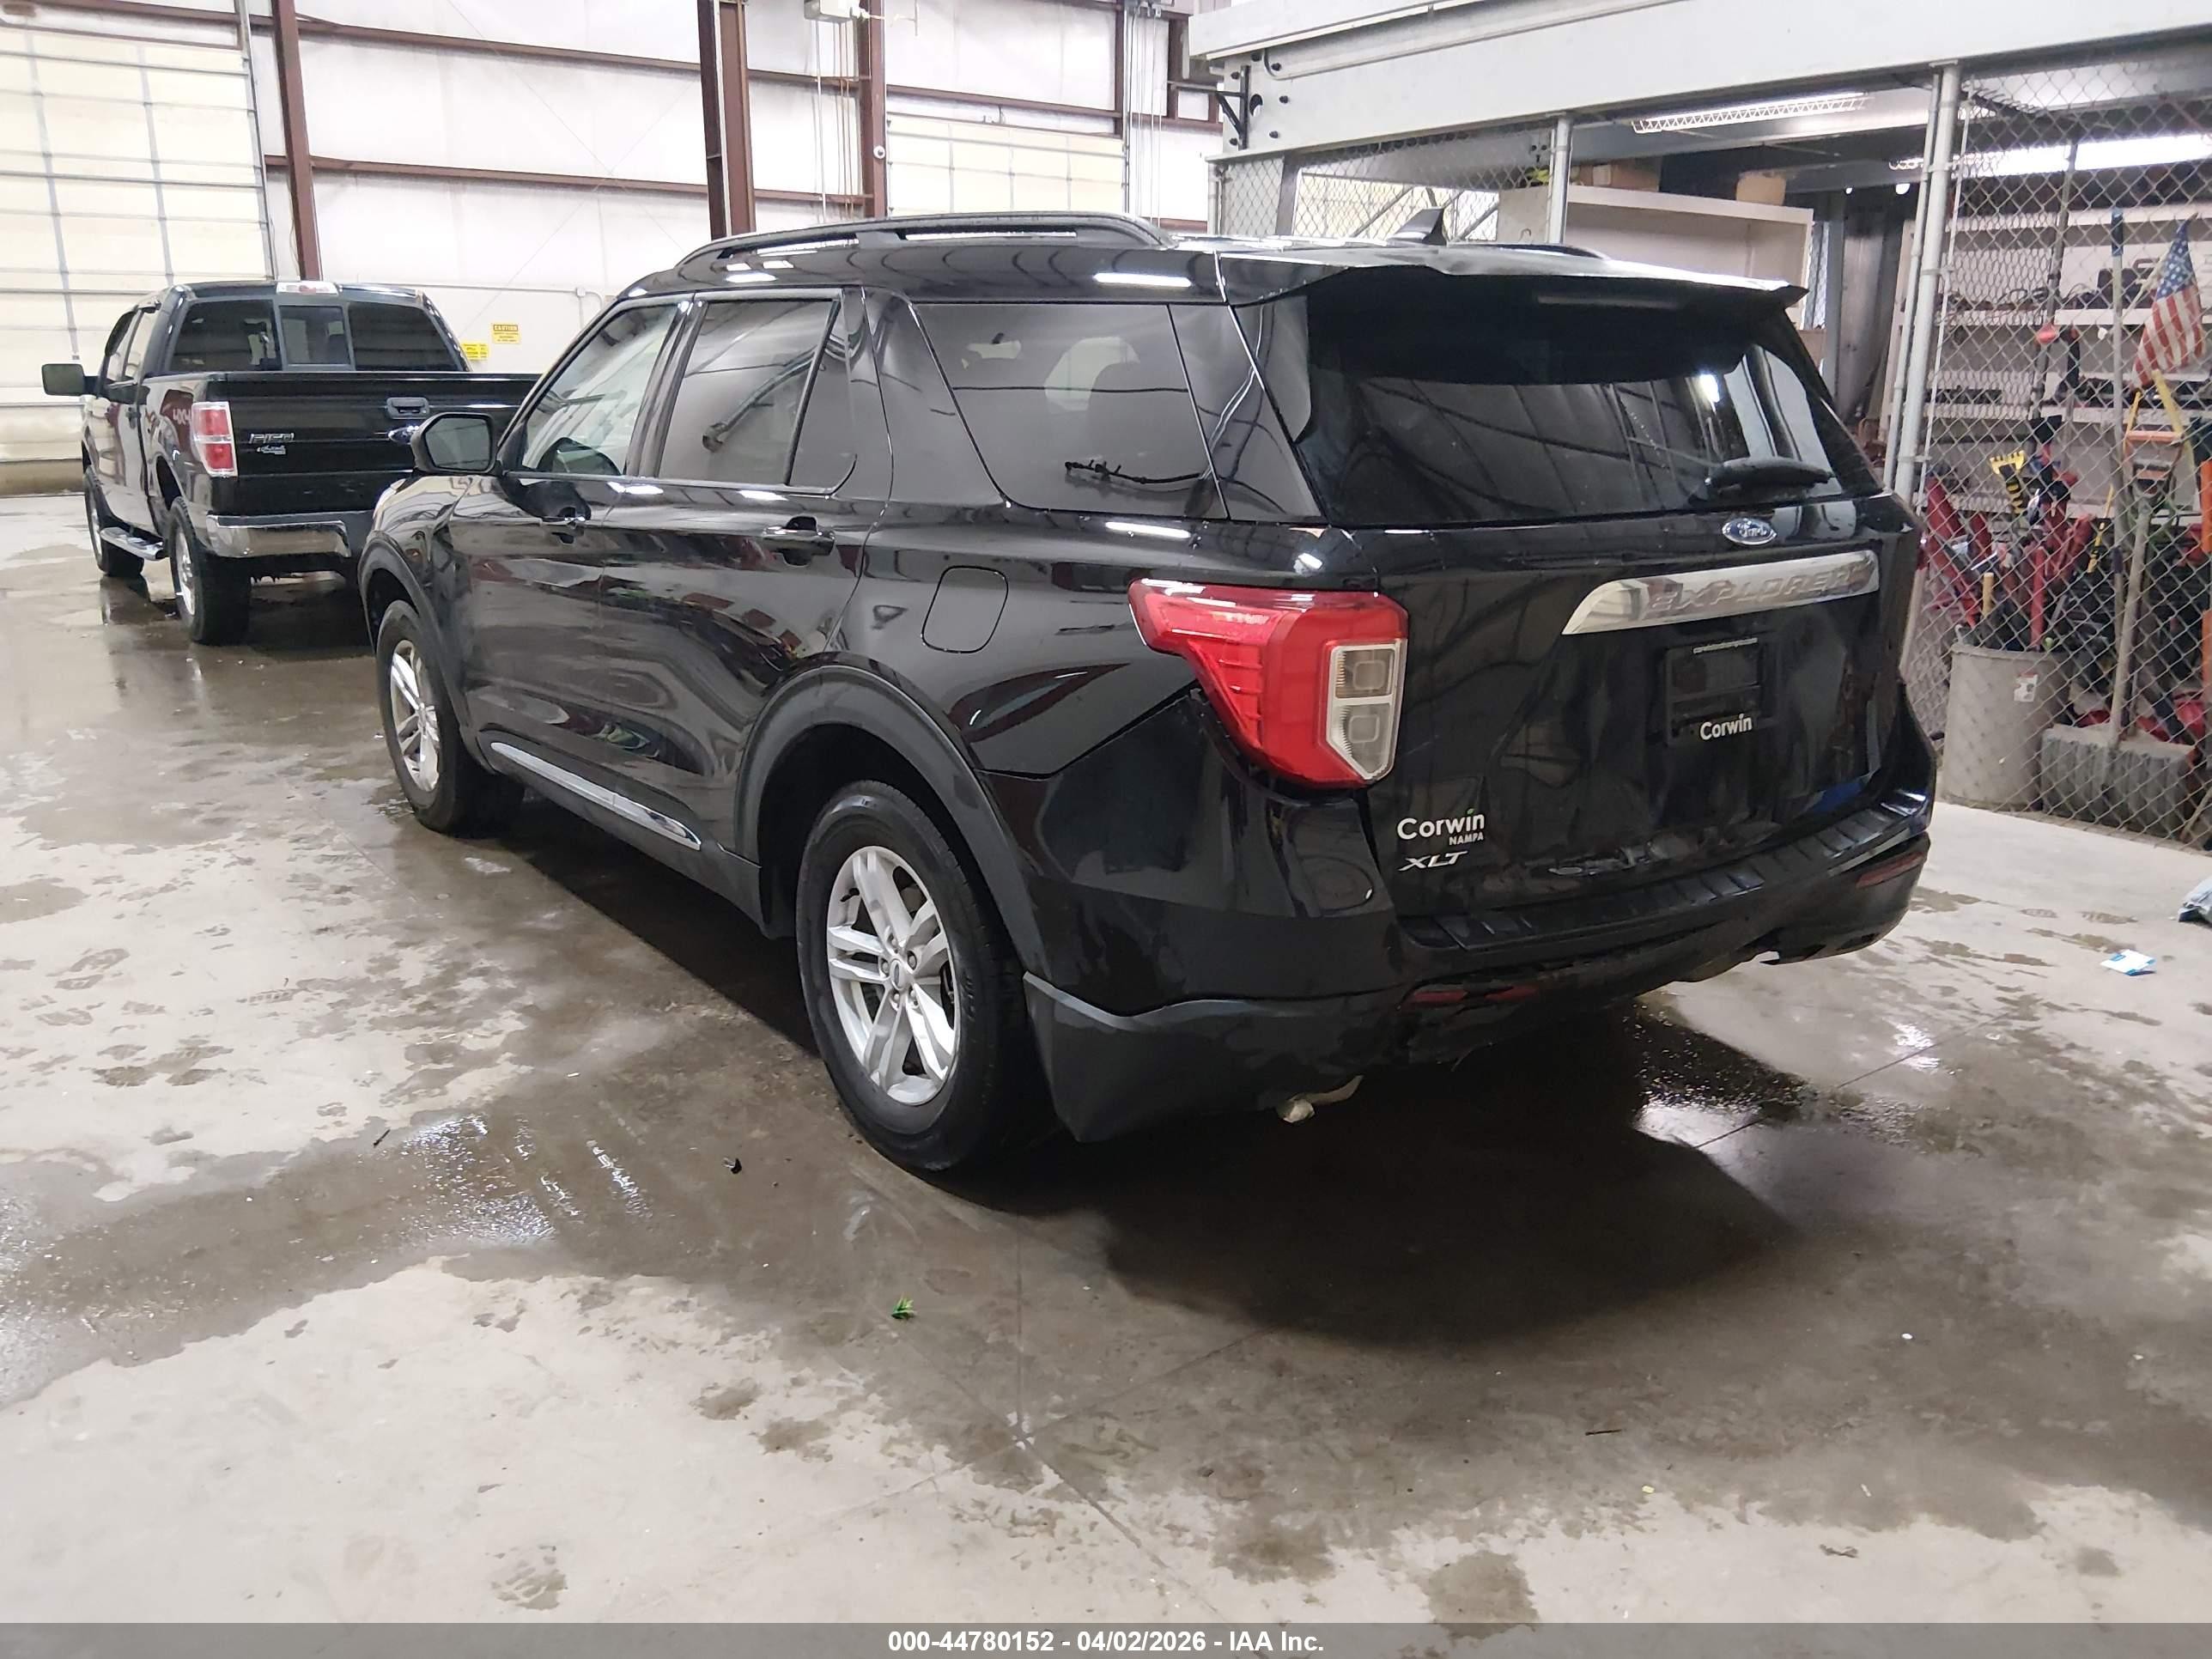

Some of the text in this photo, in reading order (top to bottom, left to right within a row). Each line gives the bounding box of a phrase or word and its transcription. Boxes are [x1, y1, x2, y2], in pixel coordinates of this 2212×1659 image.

[1648, 565, 1853, 612] EXPLORER
[1700, 713, 1753, 740] Corwin
[1396, 808, 1485, 840] Corwin
[1449, 831, 1484, 846] NAMPA
[1396, 850, 1469, 872] XLT
